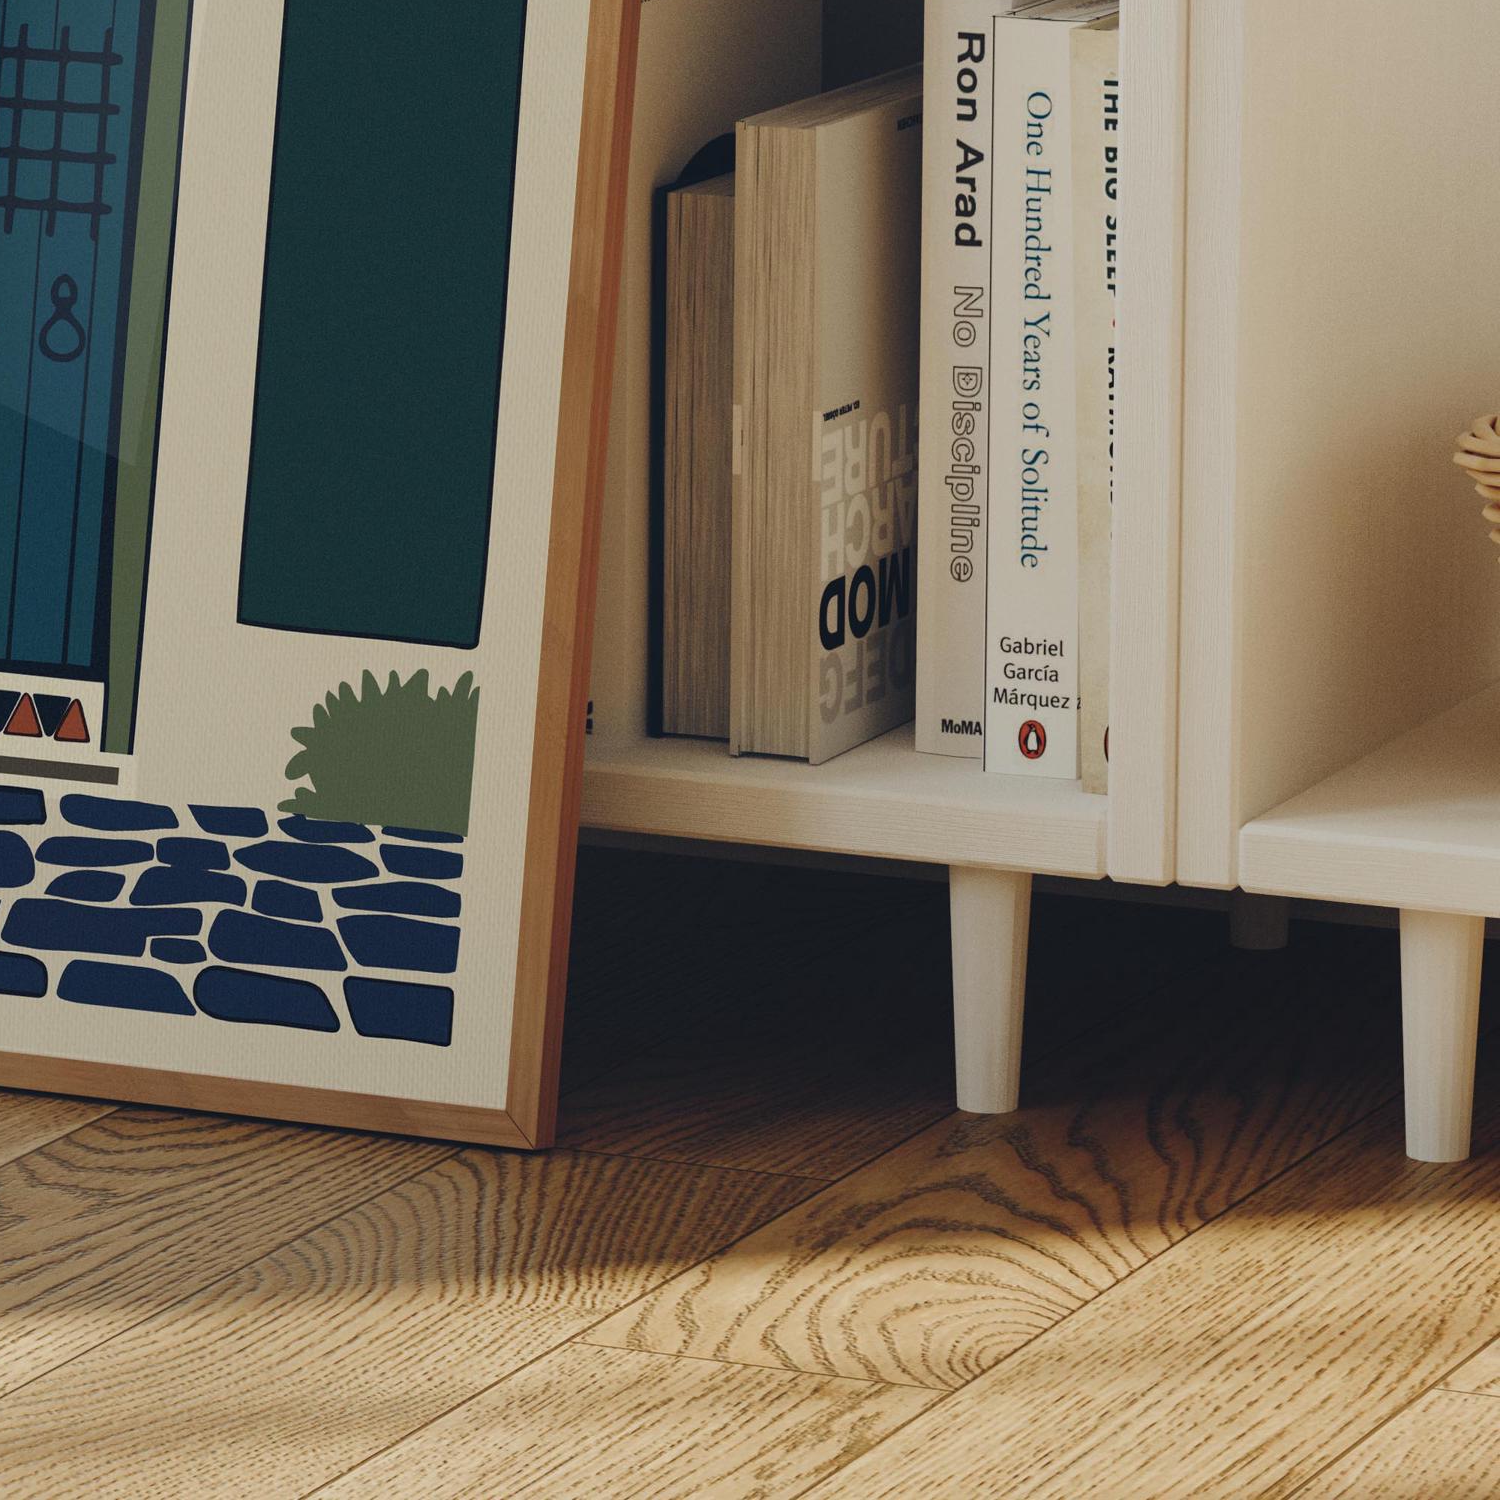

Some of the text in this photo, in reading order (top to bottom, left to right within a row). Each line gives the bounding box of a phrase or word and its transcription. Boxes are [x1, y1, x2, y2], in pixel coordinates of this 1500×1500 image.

[944, 31, 986, 583] Ron Arad No Discipline
[1020, 91, 1053, 569] One Hundred Years of Solitude
[818, 546, 911, 652] MOD
[999, 636, 1064, 657] Gabriel
[1003, 662, 1060, 683] García
[992, 686, 1070, 711] Márquez
[940, 718, 983, 736] MoMA
